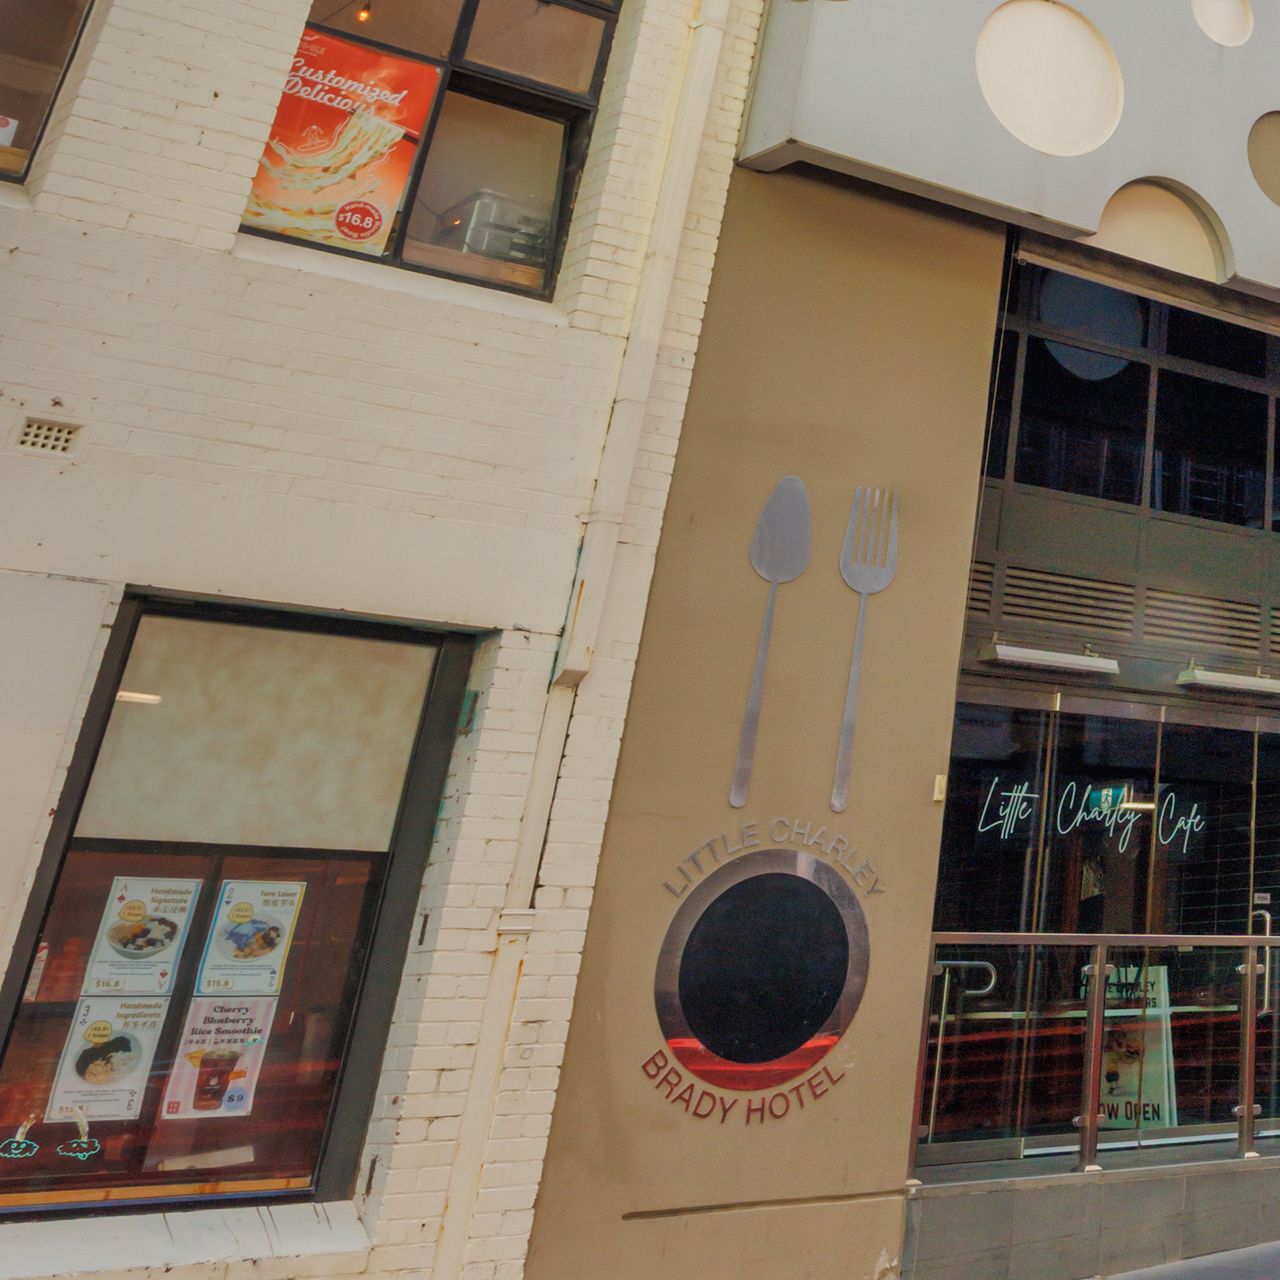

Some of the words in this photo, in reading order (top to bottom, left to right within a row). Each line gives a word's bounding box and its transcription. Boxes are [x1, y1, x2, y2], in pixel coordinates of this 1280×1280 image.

[288, 57, 408, 105] Customized
[338, 212, 373, 228] $16.8
[978, 777, 1039, 839] Little
[1057, 781, 1143, 853] Charley
[1158, 792, 1205, 853] Cafe
[661, 820, 761, 898] LITTLE
[768, 816, 885, 897] CHARLEY
[95, 979, 121, 988] $16.8
[206, 979, 230, 987] $15.8
[83, 1004, 91, 1017] 3
[119, 1002, 162, 1010] Handmade
[213, 1005, 251, 1015] Cherry
[203, 1016, 256, 1026] Blueberry
[190, 1027, 213, 1036] Rice
[214, 1026, 263, 1036] Smoothie
[640, 1049, 738, 1124] BRADY
[746, 1065, 845, 1125] HOTEL
